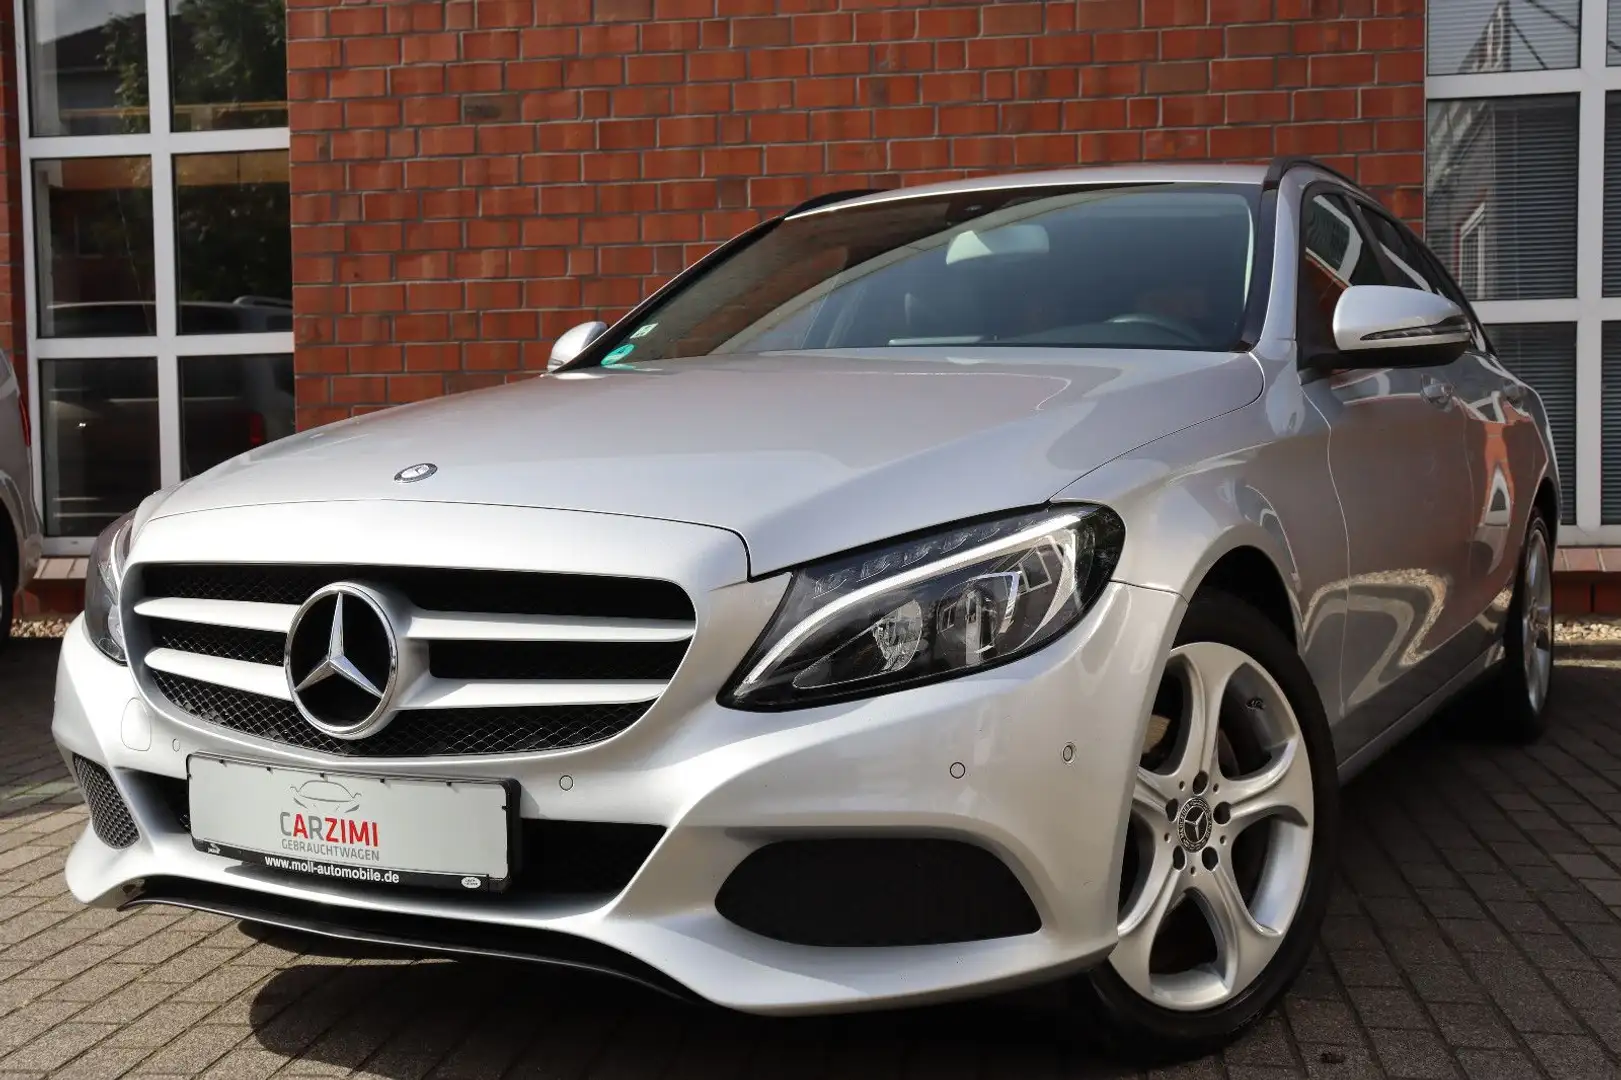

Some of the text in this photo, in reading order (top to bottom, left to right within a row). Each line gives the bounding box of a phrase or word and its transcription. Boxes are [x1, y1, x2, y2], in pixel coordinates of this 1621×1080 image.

[280, 811, 379, 847] CARZIMI
[281, 838, 380, 861] GEBRAUCHTWAGEN
[264, 856, 400, 883] www.moll-automobile.de
